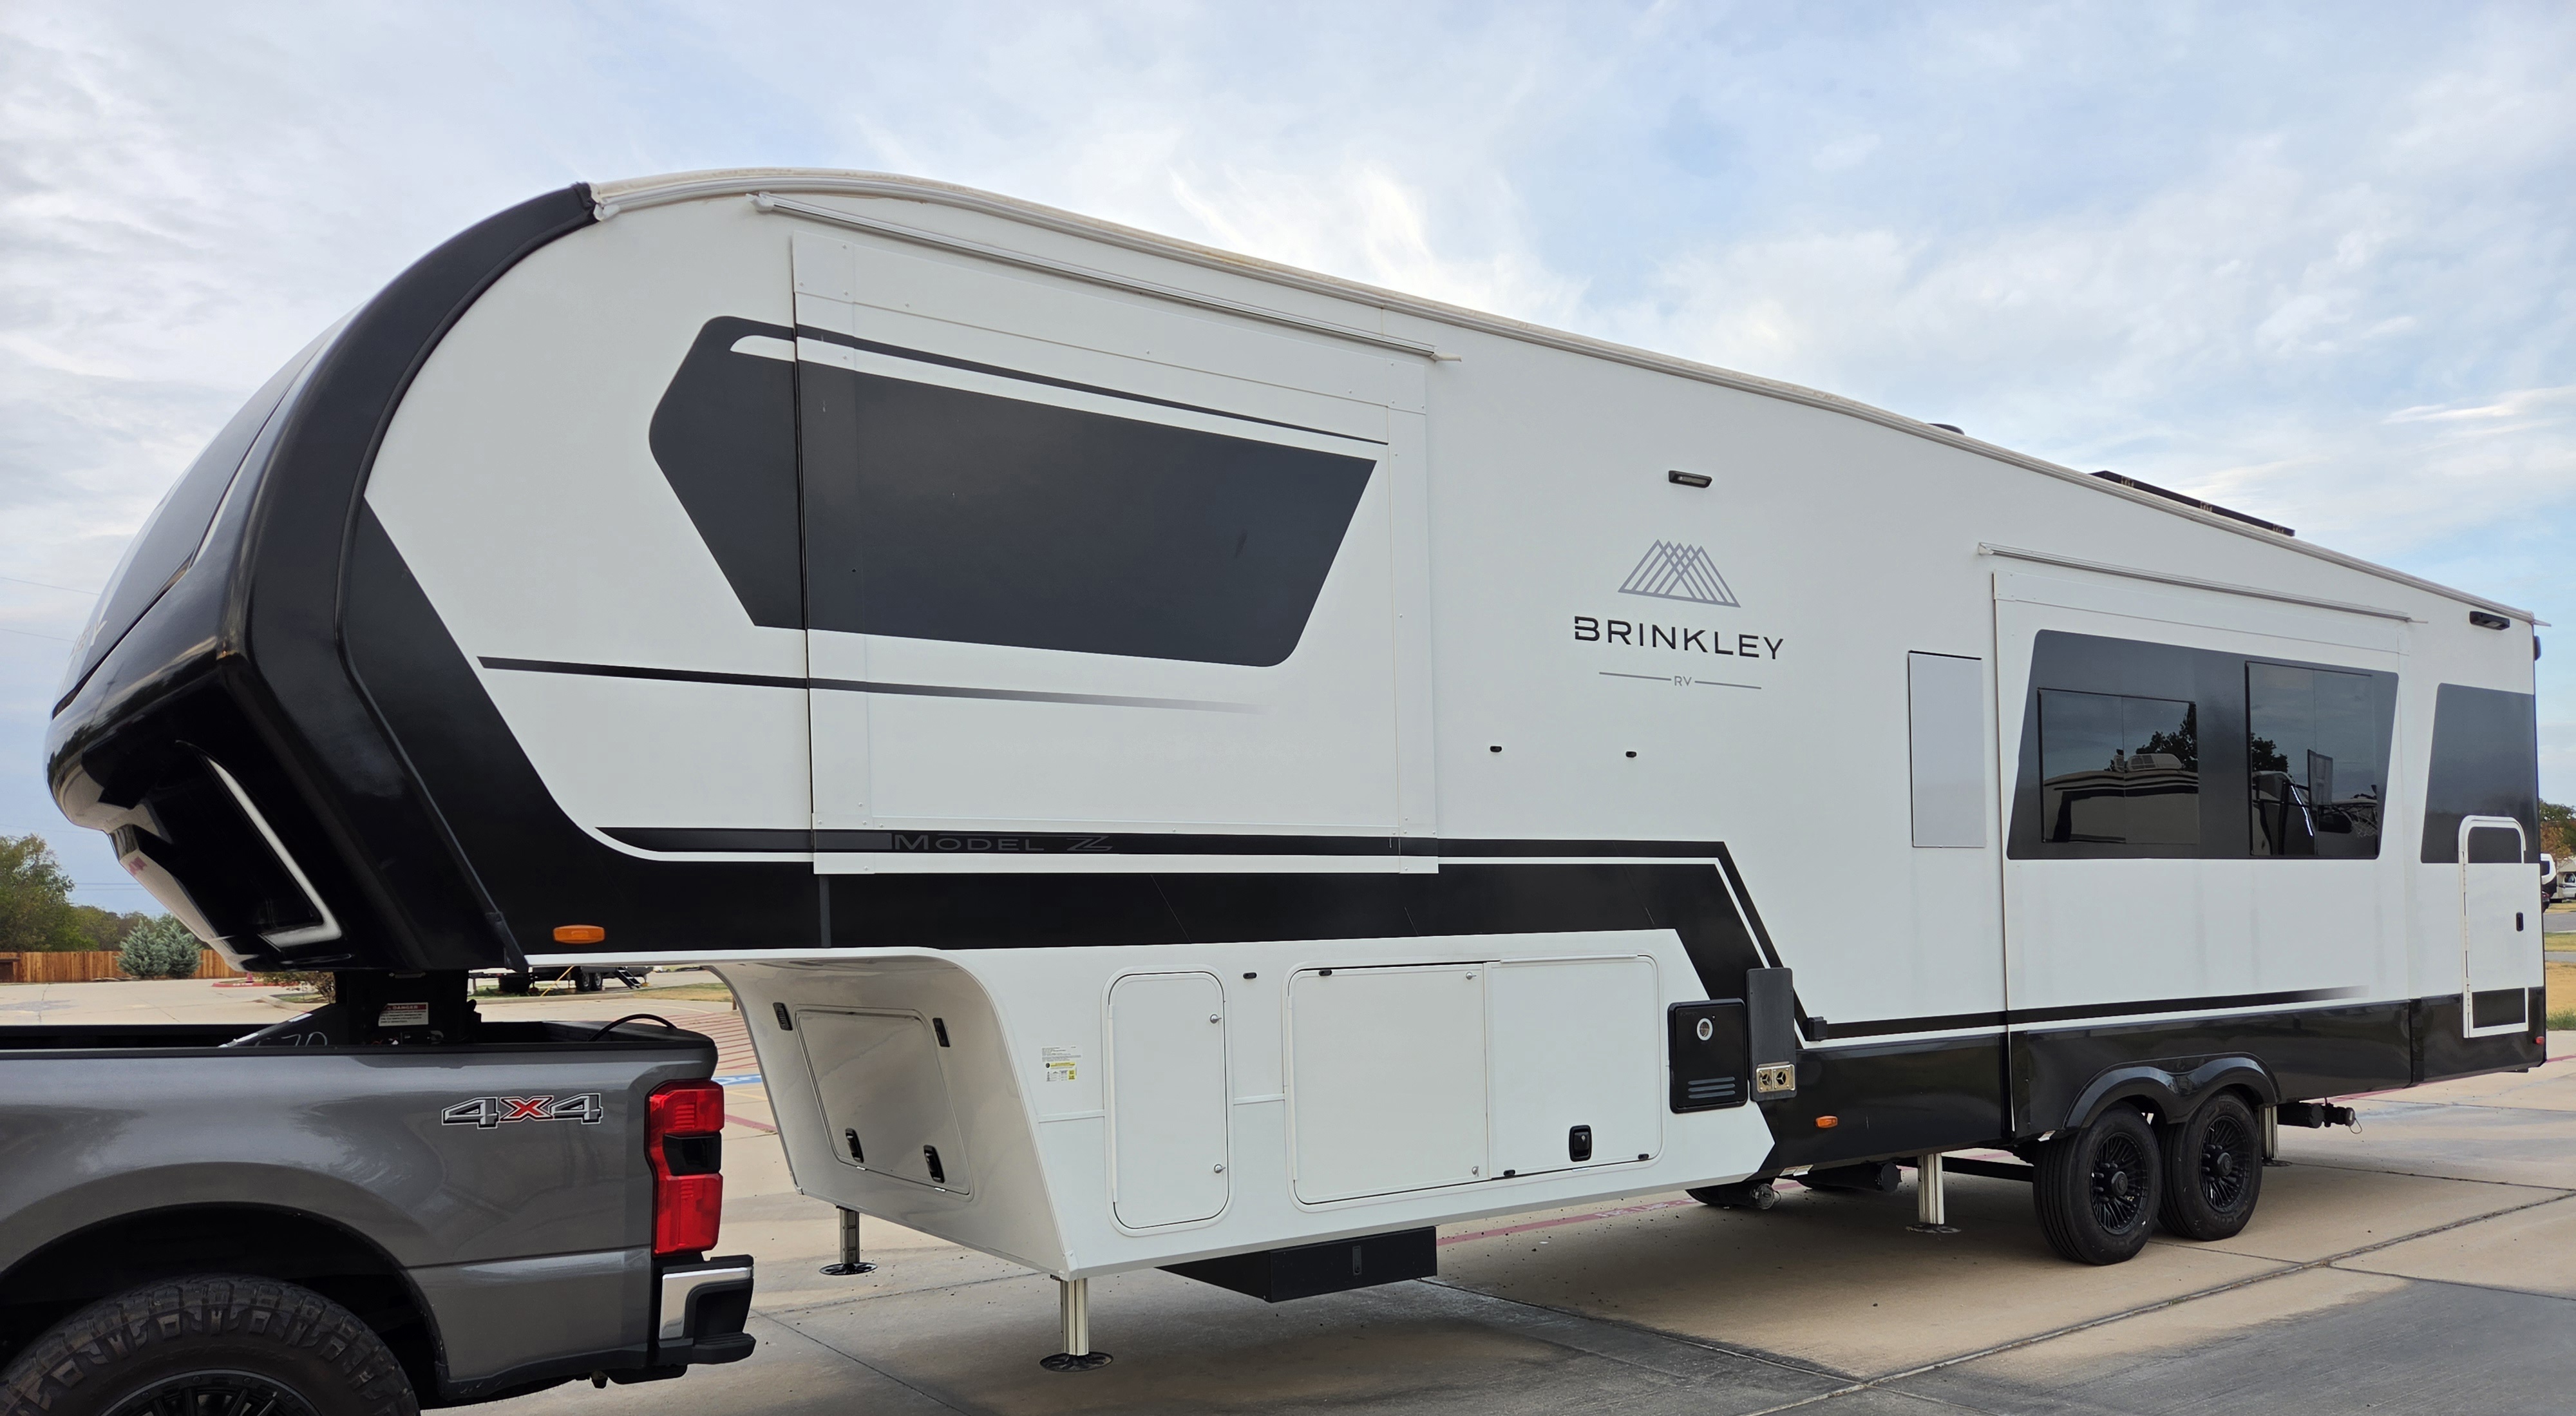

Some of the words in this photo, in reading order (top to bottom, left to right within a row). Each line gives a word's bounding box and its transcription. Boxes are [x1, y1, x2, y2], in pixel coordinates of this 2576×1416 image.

[1574, 616, 1784, 660] BRINKLEY
[1674, 675, 1692, 687] RV
[895, 834, 1045, 851] MODEL
